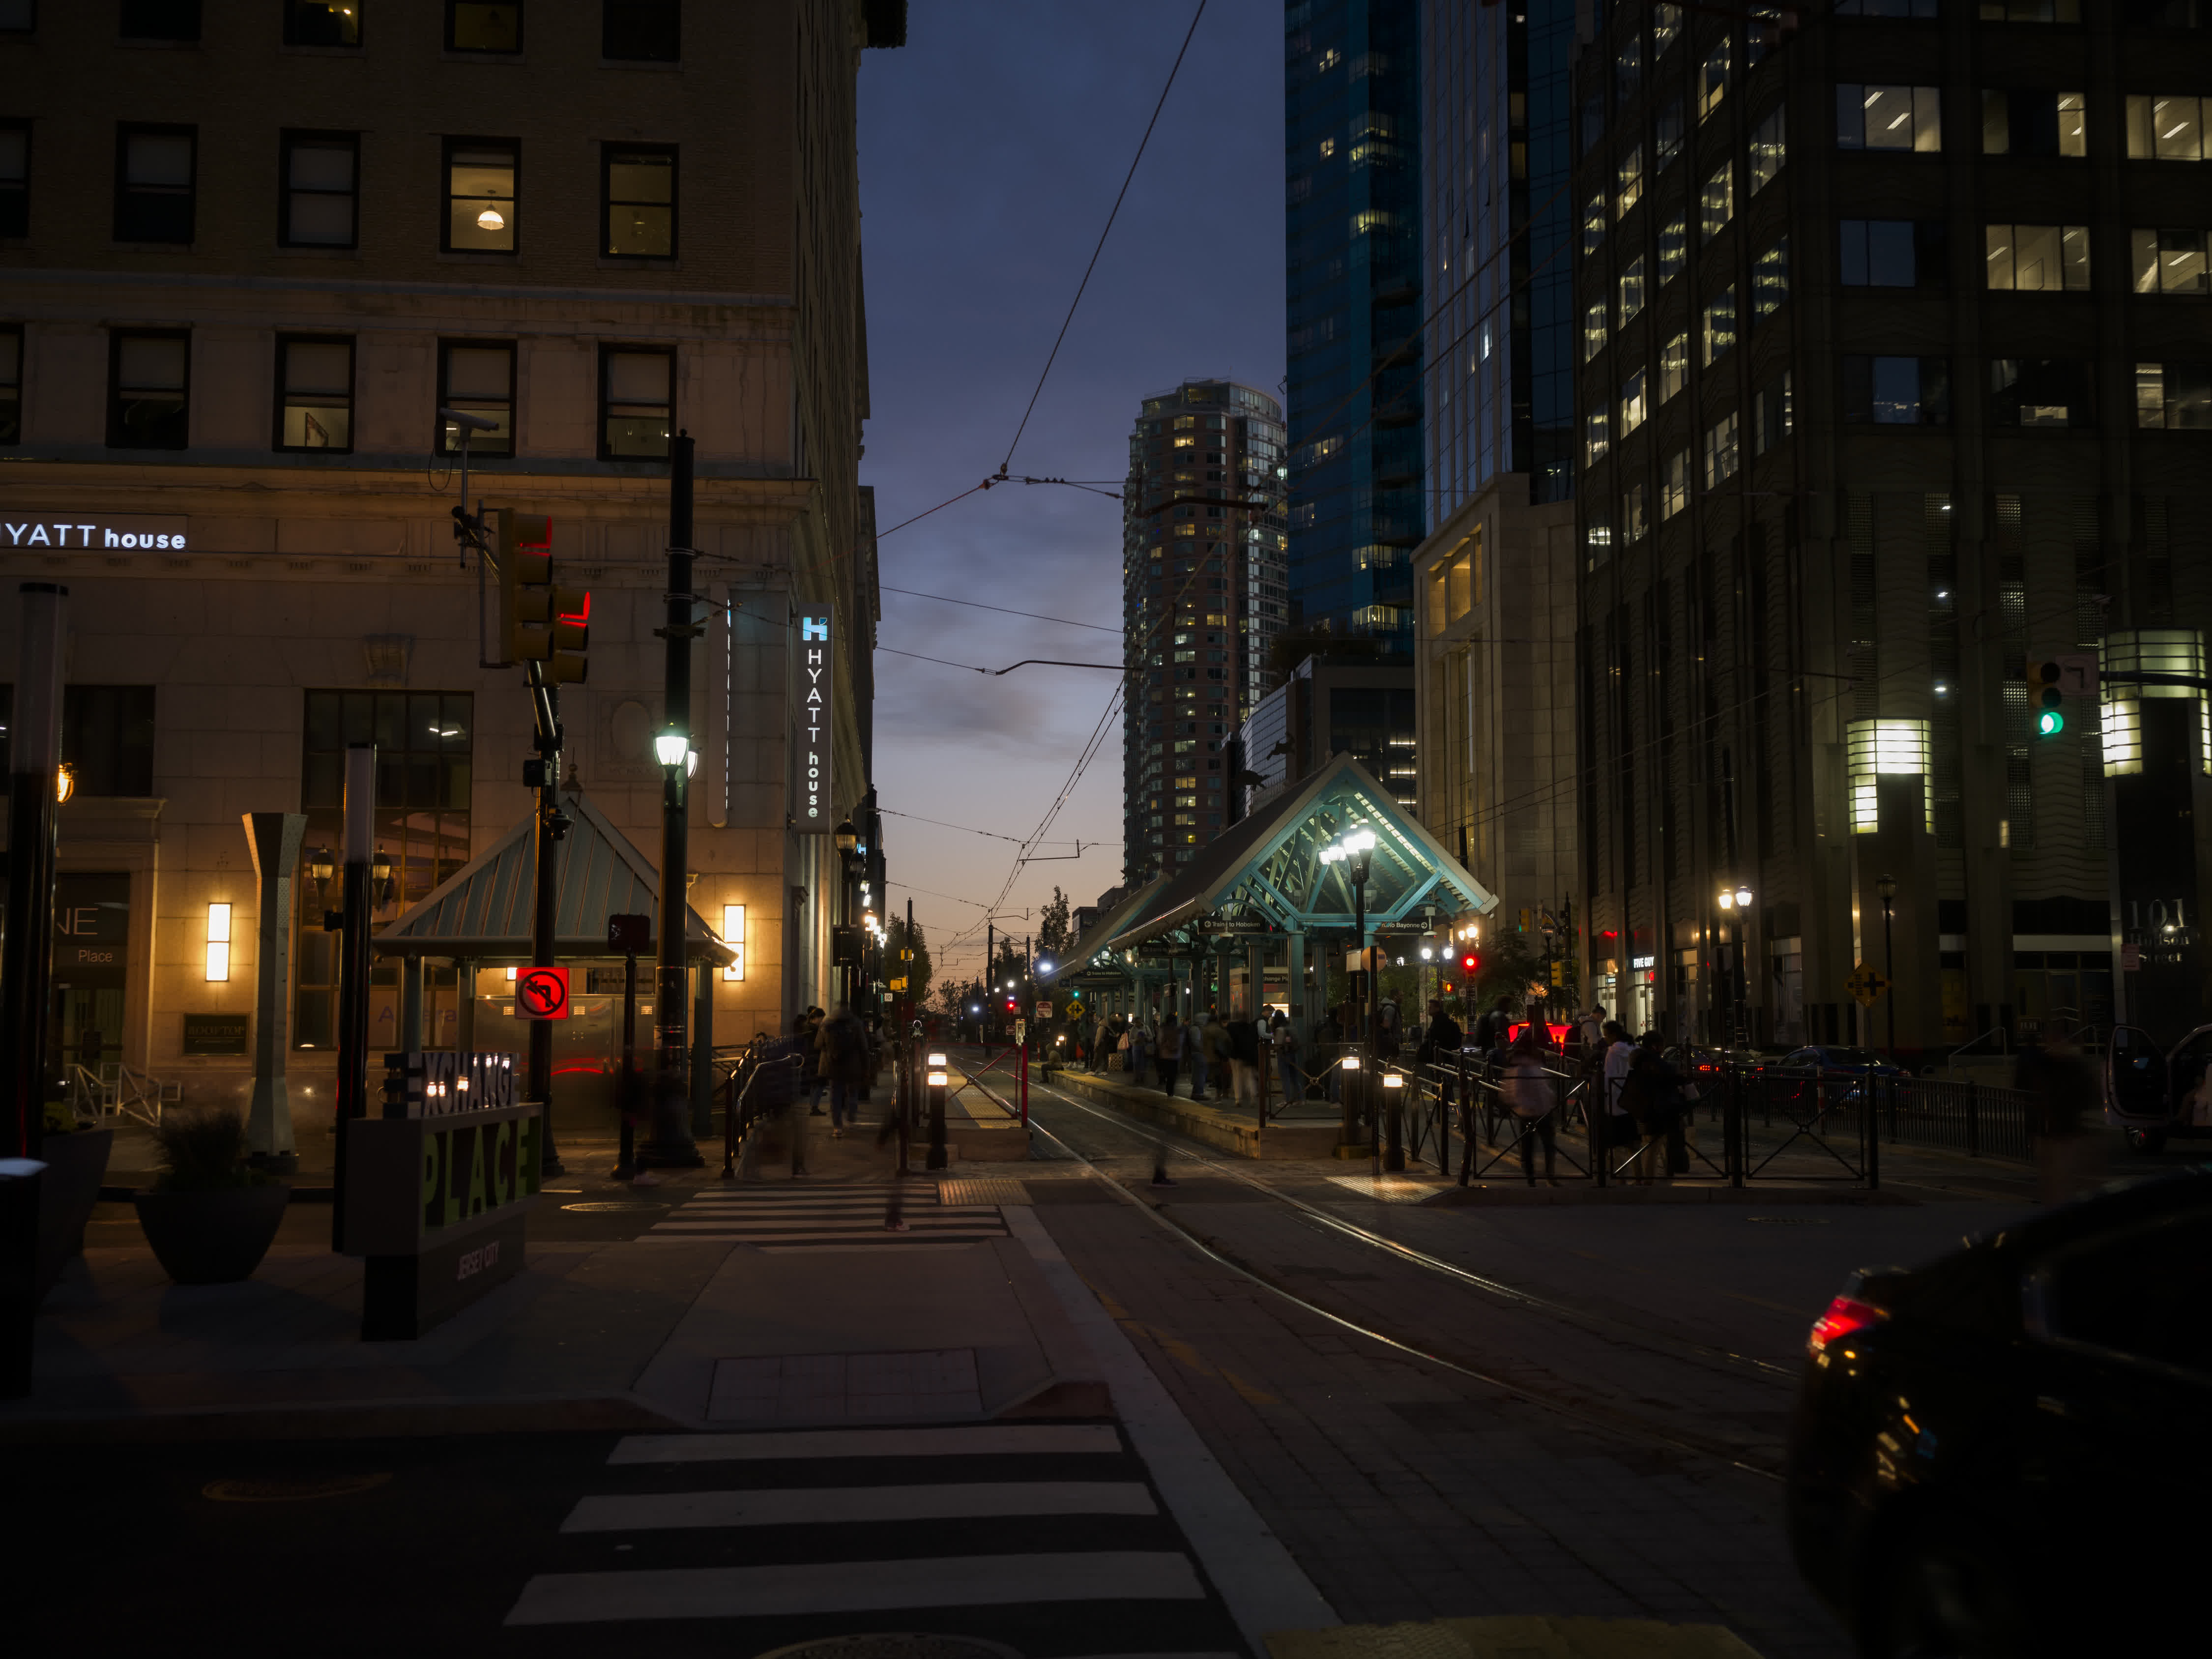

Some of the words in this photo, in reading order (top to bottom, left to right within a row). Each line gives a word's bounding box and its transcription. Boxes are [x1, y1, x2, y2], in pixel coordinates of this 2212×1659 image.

[0, 523, 96, 547] YATT
[104, 528, 186, 549] house
[807, 649, 822, 743] HYATT
[808, 751, 819, 818] house
[55, 907, 99, 935] NE
[2127, 898, 2191, 931] 101
[78, 949, 114, 963] Place
[1633, 958, 1644, 968] FIVE
[1644, 956, 1655, 967] GUY
[385, 1051, 520, 1120] EXCHANGE
[422, 1118, 532, 1232] PLACE
[457, 1248, 484, 1281] JERSEY
[484, 1239, 500, 1267] CITY
